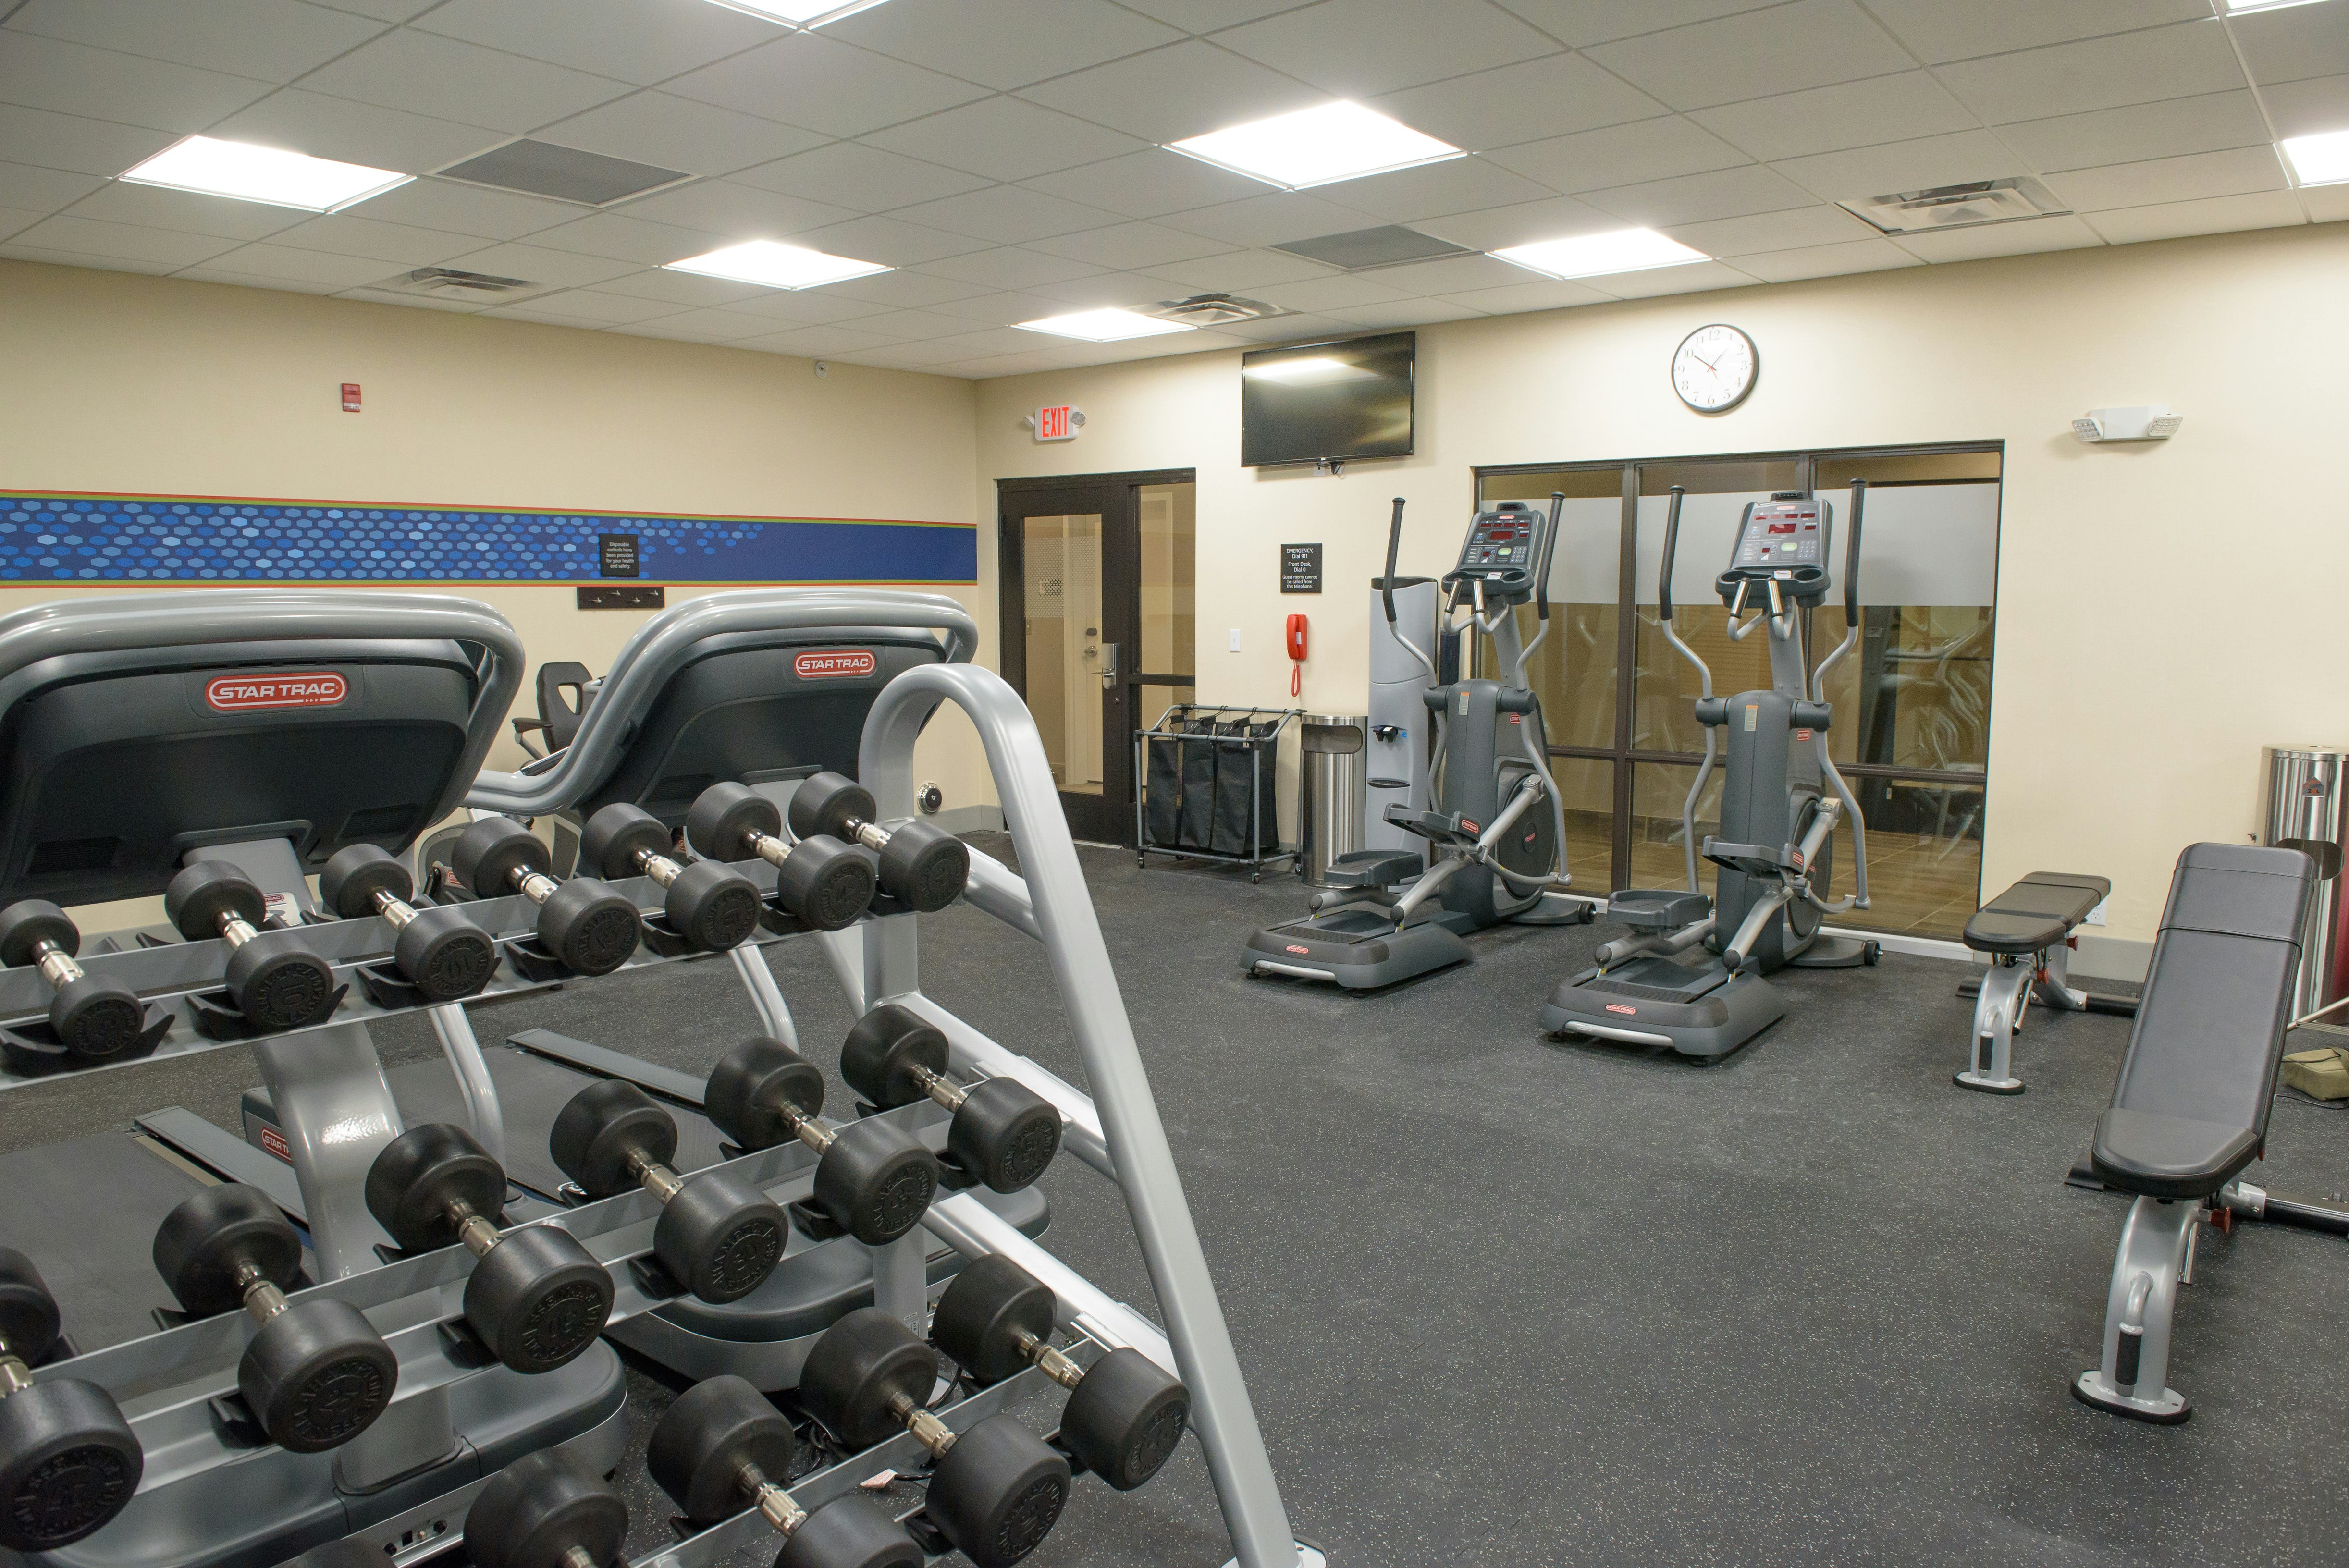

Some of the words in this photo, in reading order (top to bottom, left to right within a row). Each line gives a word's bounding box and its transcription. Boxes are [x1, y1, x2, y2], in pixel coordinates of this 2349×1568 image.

[1708, 330, 1720, 341] 12
[1696, 336, 1704, 347] 11
[1684, 348, 1693, 359] 10
[1737, 344, 1744, 355] 2
[1678, 365, 1685, 375] 9
[1741, 360, 1747, 370] 3
[1682, 380, 1688, 391] 8
[1735, 377, 1742, 387] 4
[1693, 392, 1699, 402] 7
[1708, 394, 1714, 404] 6
[1723, 389, 1730, 400] 5
[1042, 406, 1069, 438] EXIT
[800, 659, 834, 670] STAR
[836, 658, 869, 668] TRAC
[218, 685, 275, 699] STAR
[279, 682, 336, 696] TRAC
[282, 983, 305, 1006] 10
[264, 1135, 282, 1150] STAR
[733, 1244, 757, 1271] 30
